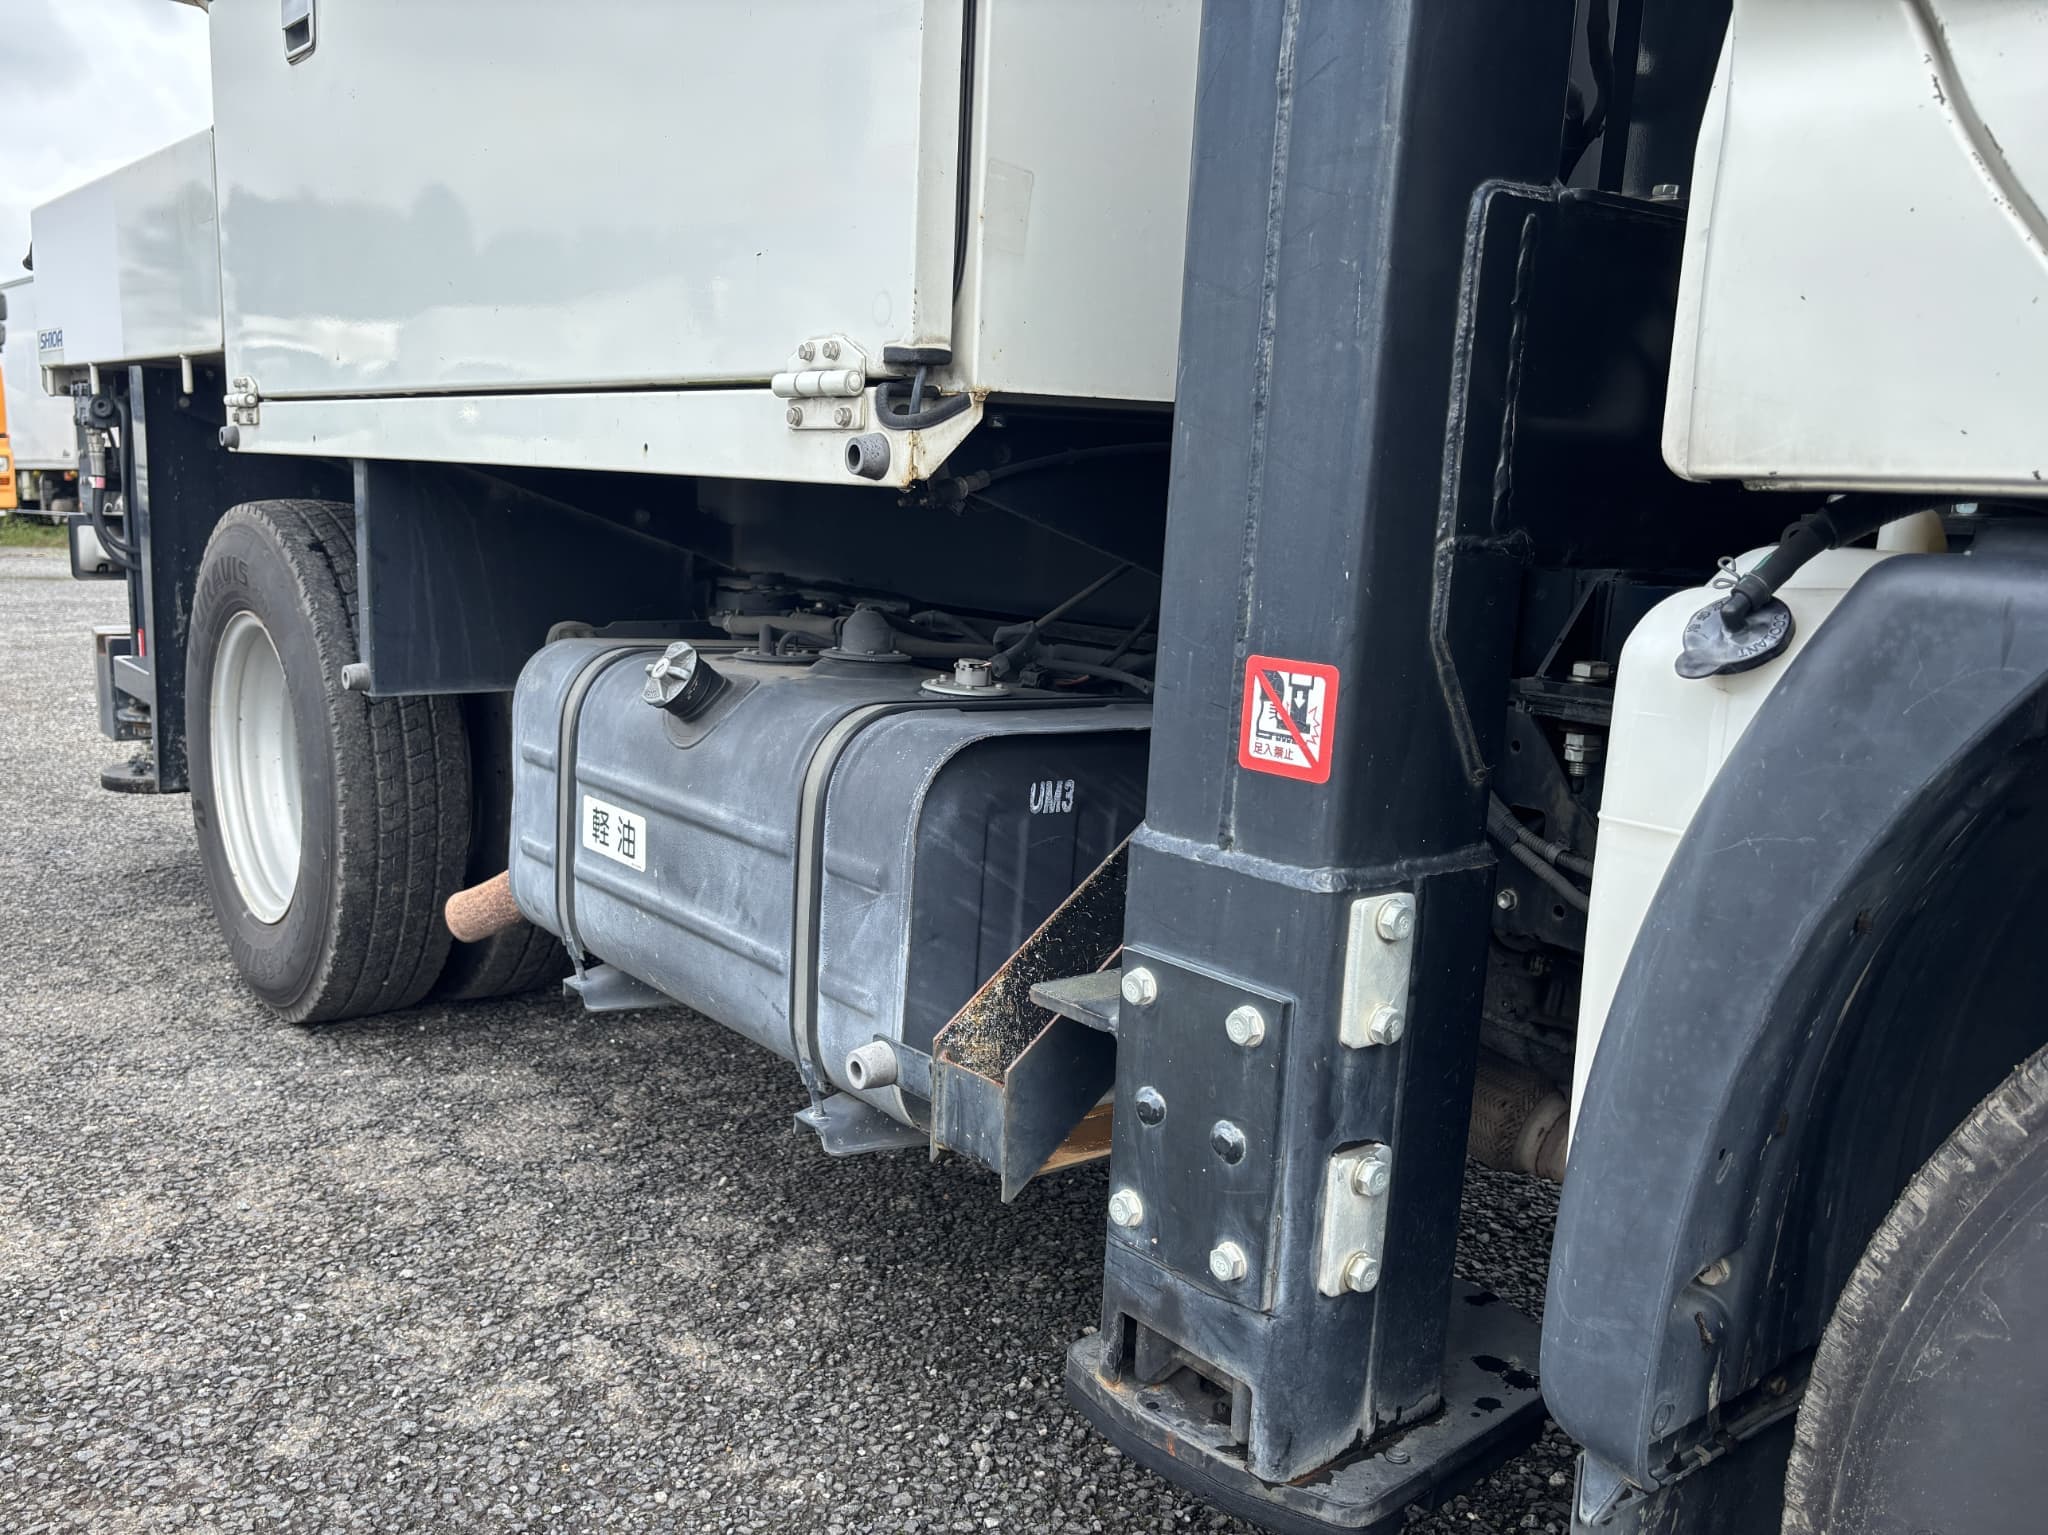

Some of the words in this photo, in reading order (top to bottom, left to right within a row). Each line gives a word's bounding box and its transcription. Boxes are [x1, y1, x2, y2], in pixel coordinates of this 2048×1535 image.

[1737, 612, 1787, 658] COOLANT
[1253, 741, 1294, 761] 足入禁止
[1029, 779, 1075, 815] UM3
[592, 805, 636, 860] 軽油
